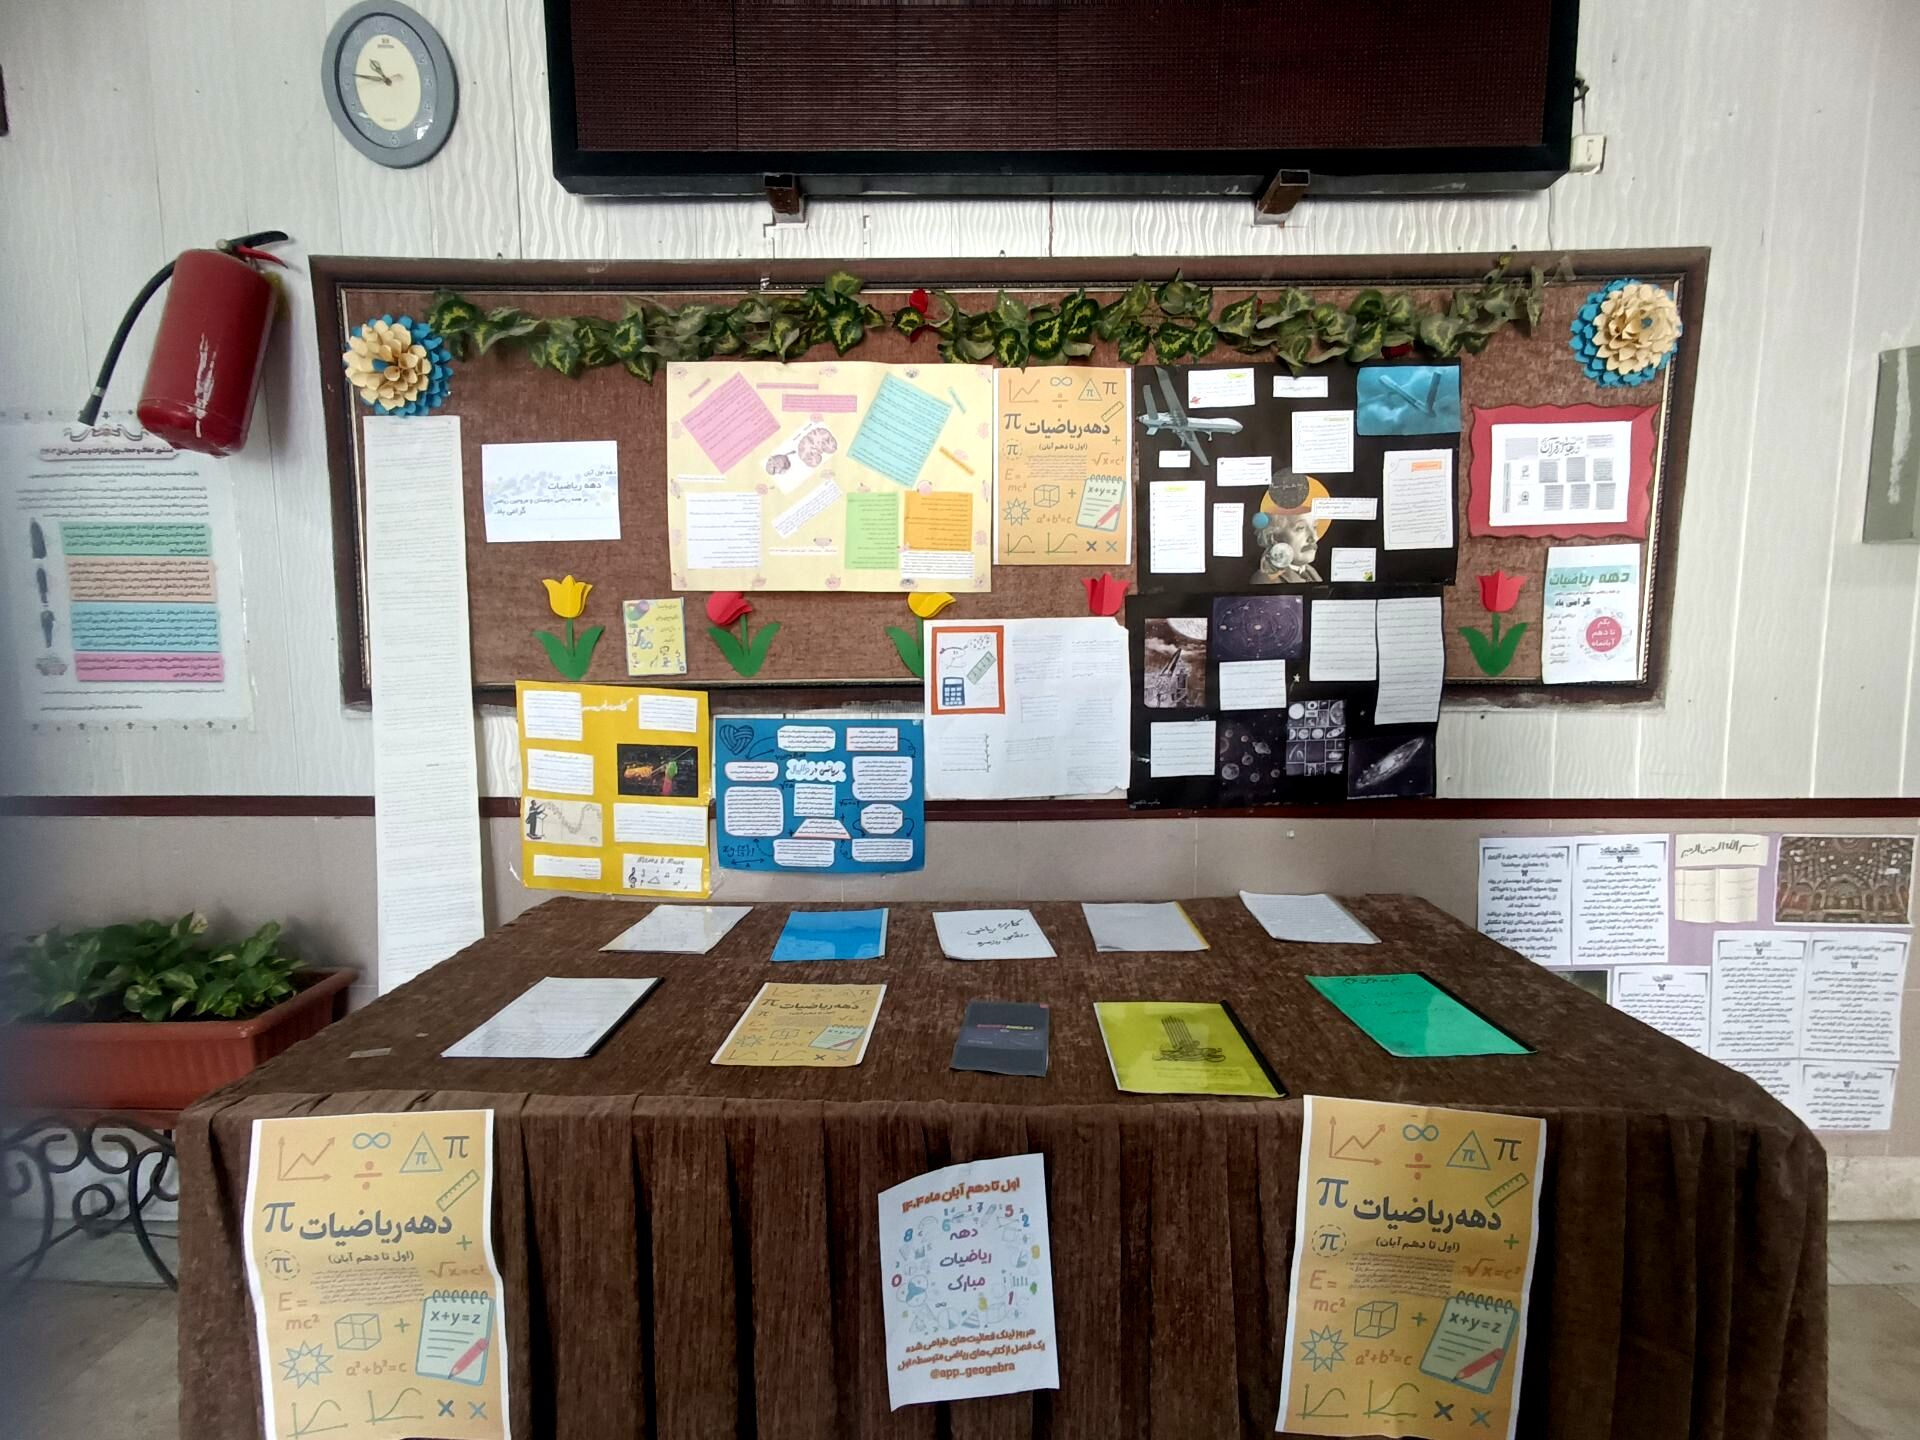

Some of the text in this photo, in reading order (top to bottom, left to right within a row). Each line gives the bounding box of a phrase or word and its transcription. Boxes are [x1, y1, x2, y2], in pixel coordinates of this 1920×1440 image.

[1004, 413, 1022, 430] π
[1024, 417, 1110, 438] دهه ریاضیات
[1007, 444, 1019, 456] π
[547, 480, 602, 492] دهه ریاضیات
[1549, 570, 1630, 588] دهه ریاضیات
[443, 1135, 470, 1159] π
[1460, 1148, 1477, 1163] π
[1493, 1137, 1522, 1162] π
[415, 1151, 428, 1165] π
[942, 1182, 965, 1202] آبان
[965, 1184, 991, 1199] دهم
[991, 1180, 1001, 1191] تا
[1000, 1177, 1021, 1193] اول
[1316, 1177, 1349, 1210] π
[262, 1201, 295, 1233] π
[1004, 1204, 1015, 1218] 5
[1353, 1196, 1502, 1234] دهه ریاضیات
[300, 1209, 453, 1247] دهه ریاضیات
[1021, 1214, 1030, 1228] 2
[903, 1227, 914, 1243] 8
[950, 1227, 978, 1241] دهه
[1319, 1233, 1338, 1251] π
[1376, 1236, 1461, 1254] (اول تا دهم آبان)
[272, 1257, 292, 1274] π
[327, 1250, 415, 1266] (اول تا دهم آبان)
[940, 1248, 992, 1267] ریاضیات
[947, 1274, 986, 1292] مبارک
[1313, 1297, 1346, 1314] mc²
[285, 1313, 320, 1331] mc²
[430, 1308, 481, 1326] x+y=z
[1448, 1311, 1503, 1334] x+y=z
[1355, 1349, 1413, 1367] a²+b²=c
[346, 1360, 408, 1377] a²+b²=c
[929, 1361, 1016, 1380] @app_geogebra
